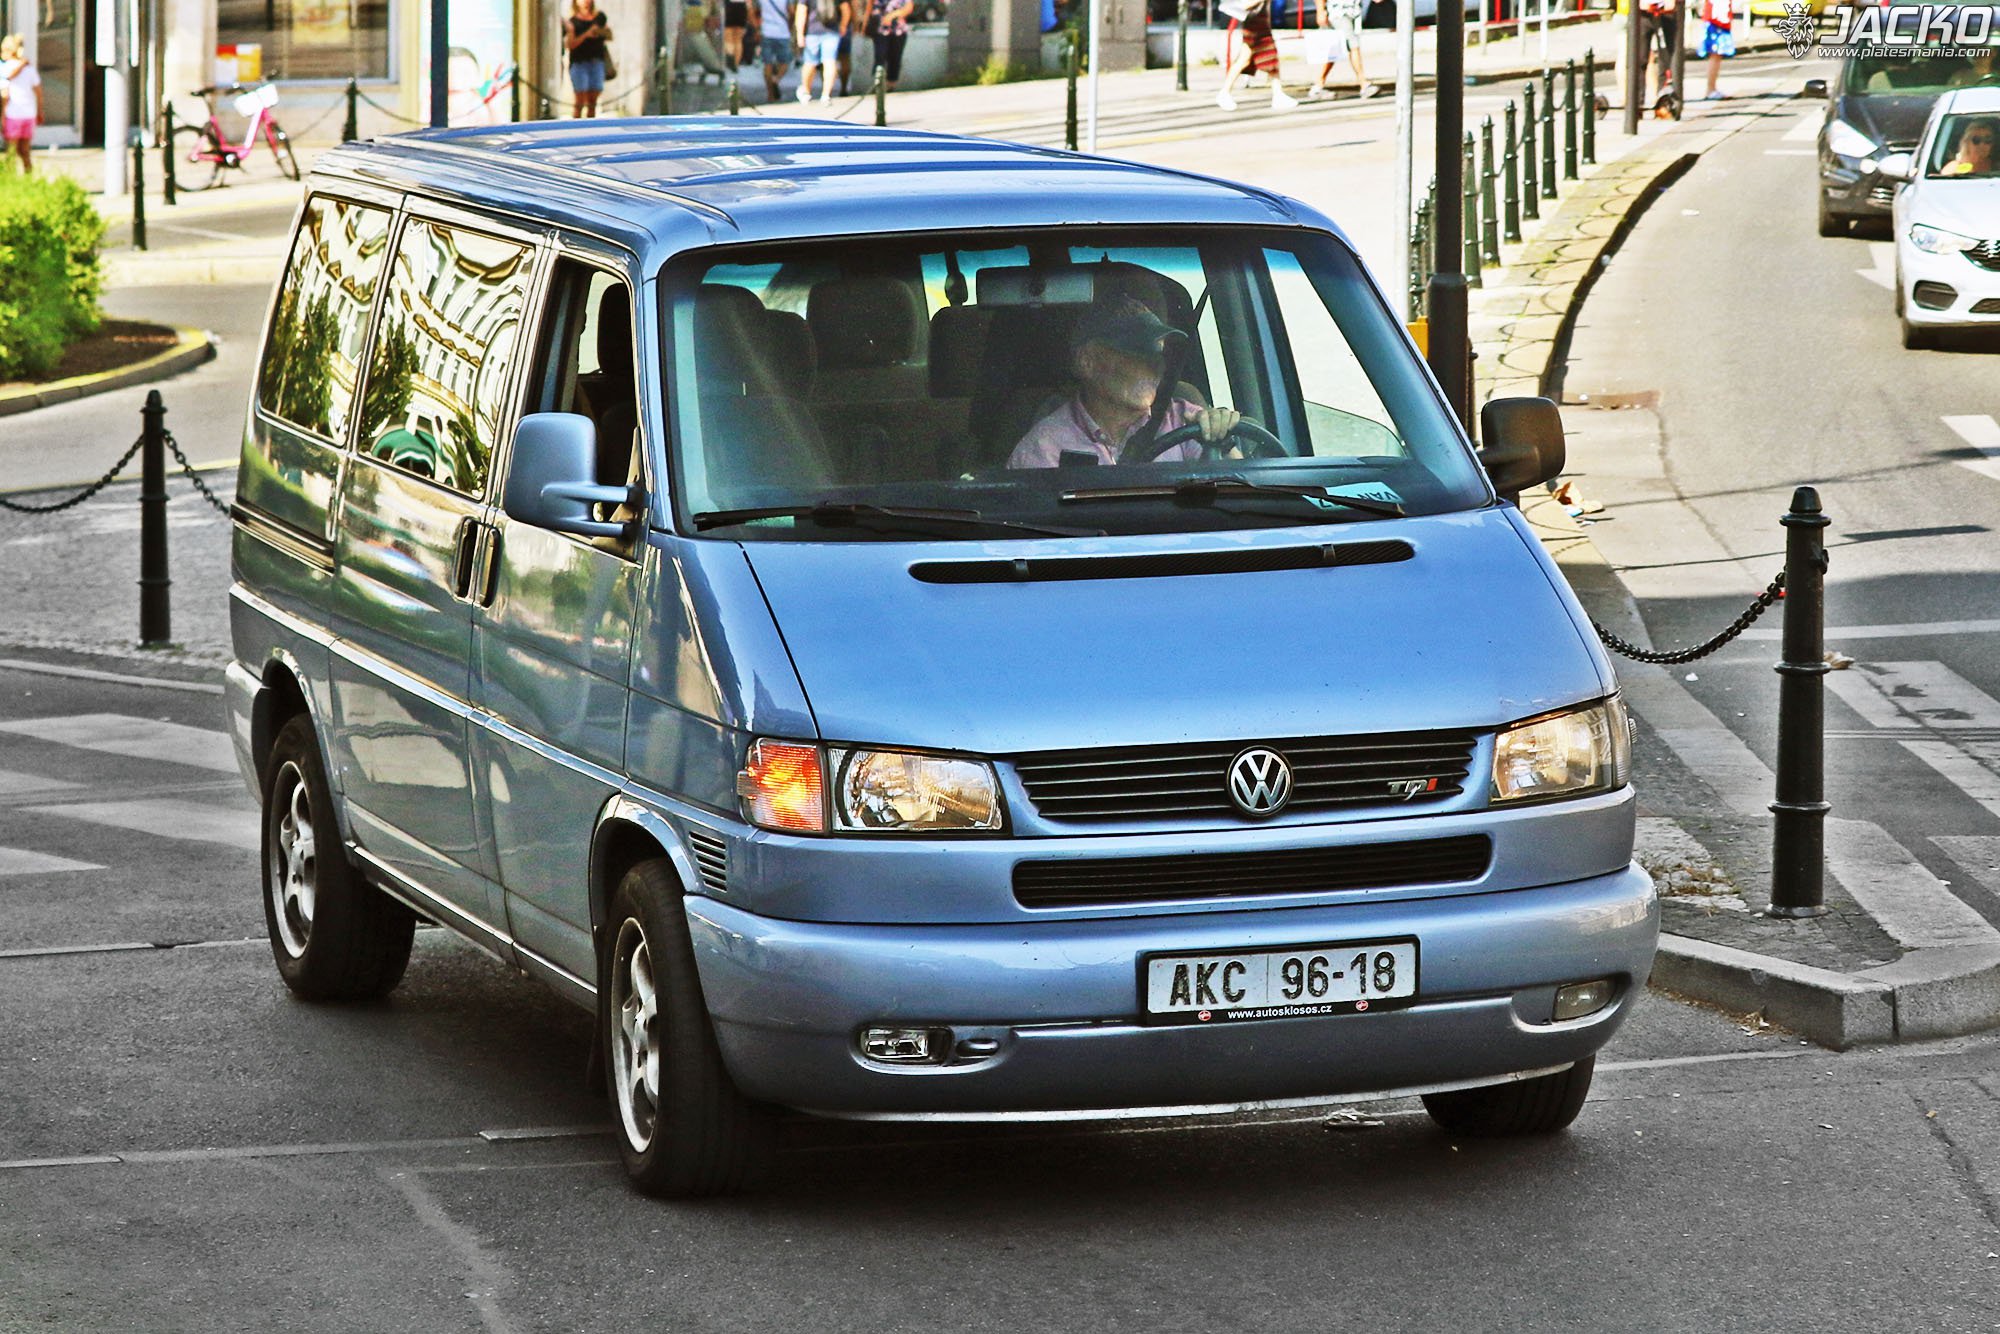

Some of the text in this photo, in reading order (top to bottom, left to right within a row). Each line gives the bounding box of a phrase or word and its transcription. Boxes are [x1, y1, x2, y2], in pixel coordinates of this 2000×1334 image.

[1230, 749, 1291, 812] VW
[1169, 951, 1396, 1006] AKC 96-18
[1227, 1004, 1332, 1019] www.autosklosos.cz
